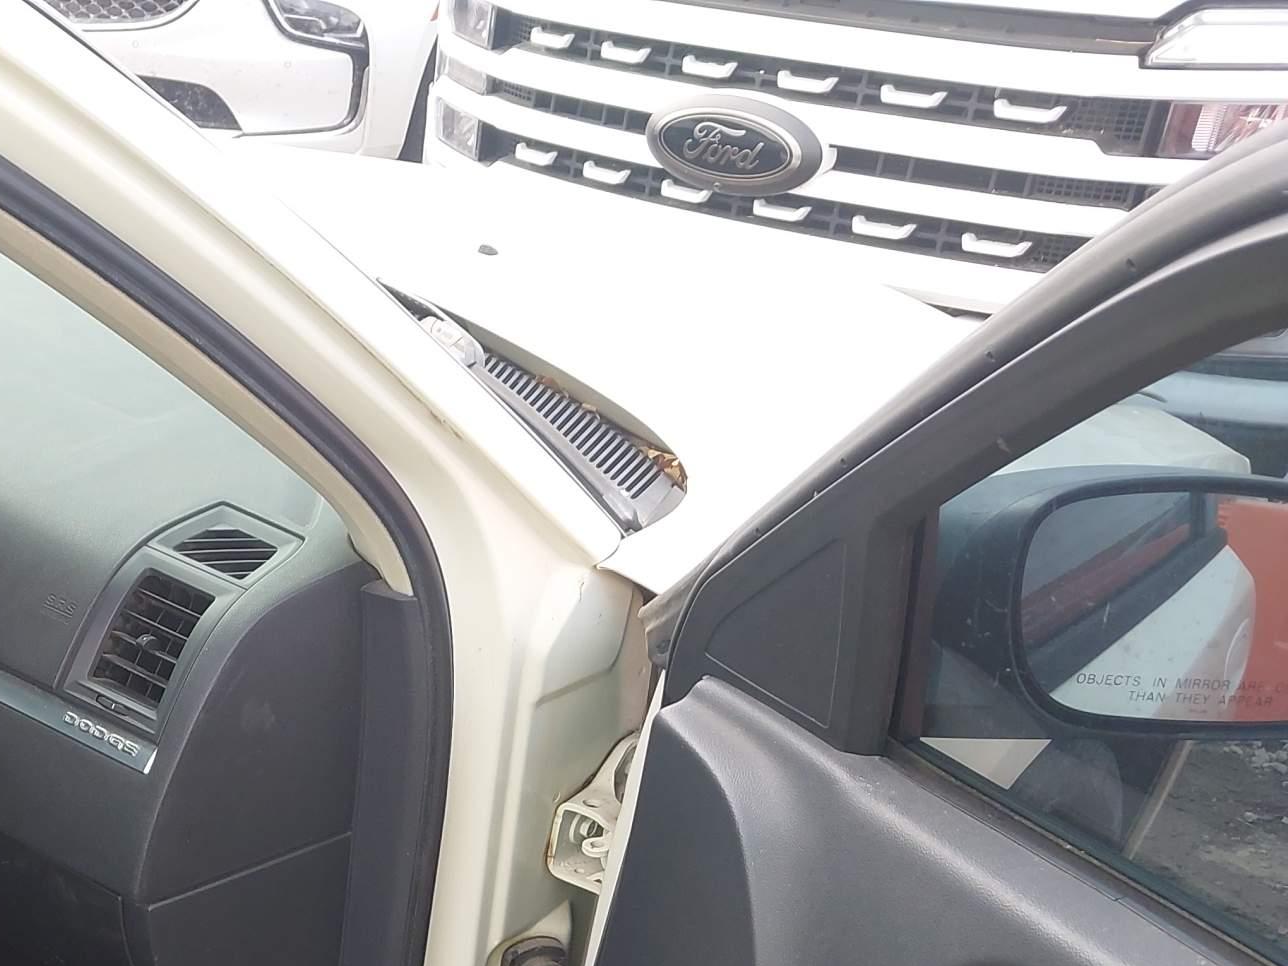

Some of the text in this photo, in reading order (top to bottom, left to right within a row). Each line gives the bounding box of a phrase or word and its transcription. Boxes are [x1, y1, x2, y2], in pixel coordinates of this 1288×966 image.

[683, 121, 765, 170] Ford
[1076, 673, 1142, 687] OBJECTS
[1152, 677, 1167, 688] IN
[1175, 677, 1231, 691] MIRROR
[1128, 690, 1273, 707] THAN THEY APPEAR
